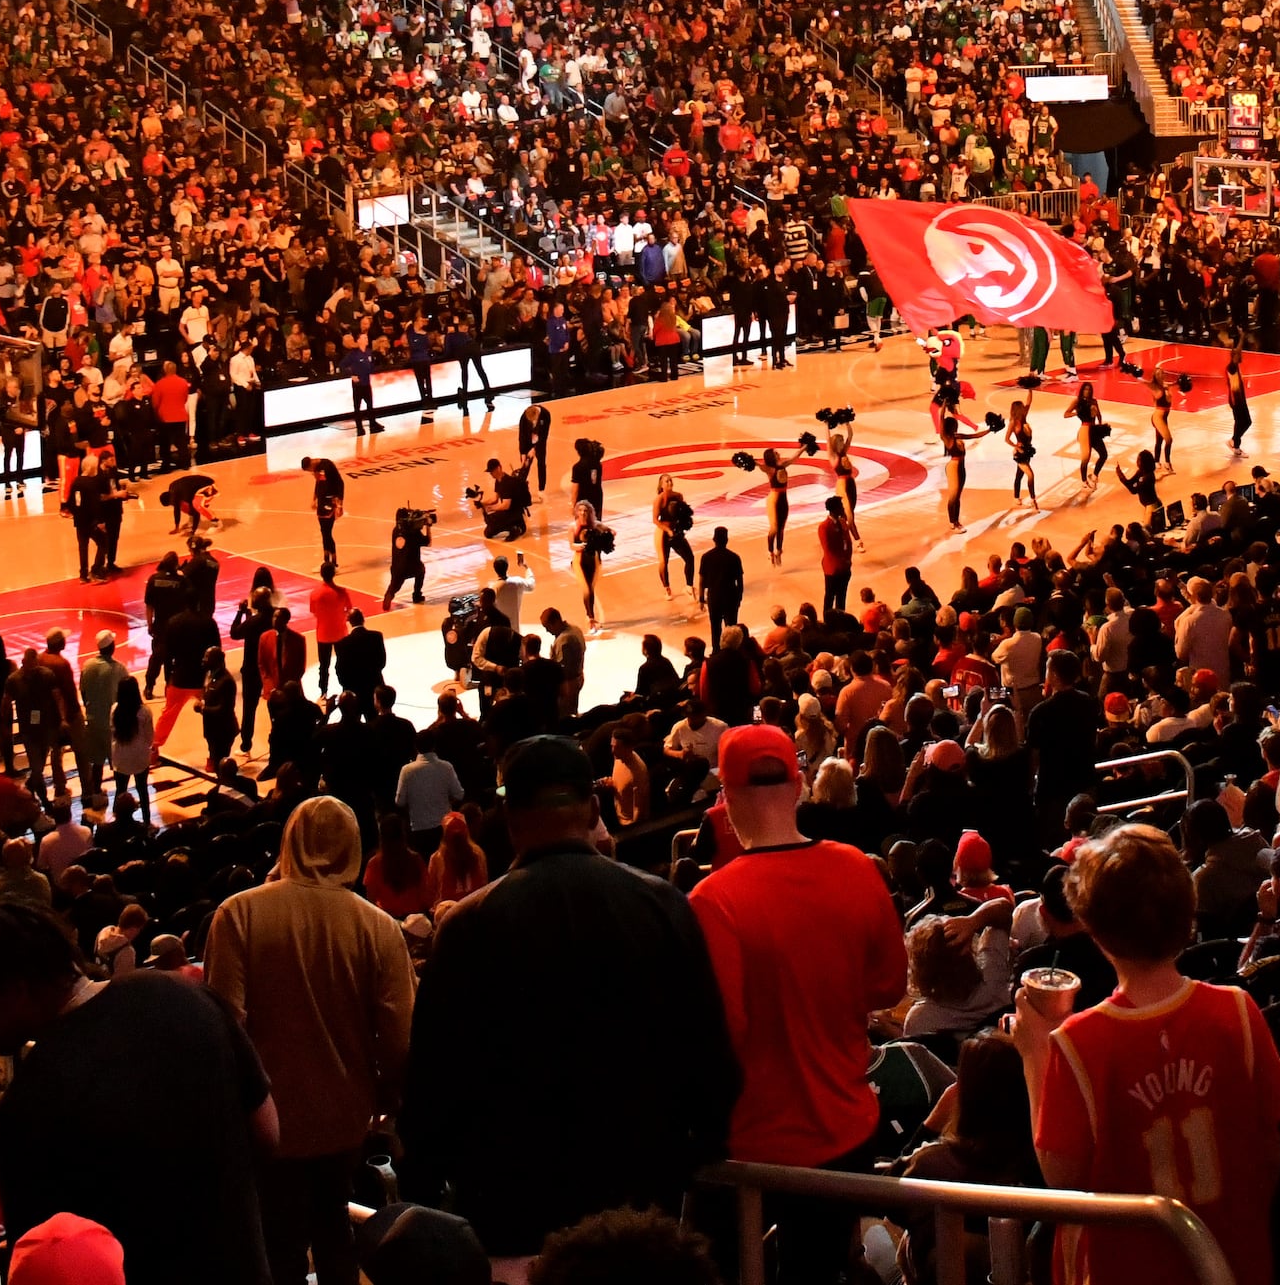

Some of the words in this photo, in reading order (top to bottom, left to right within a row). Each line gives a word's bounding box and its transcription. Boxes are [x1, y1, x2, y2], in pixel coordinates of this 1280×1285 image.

[1233, 106, 1256, 126] 24
[648, 399, 735, 420] ARENA
[346, 456, 450, 480] ARENA
[1128, 1058, 1213, 1111] YOUNG
[1142, 1105, 1221, 1205] 11
